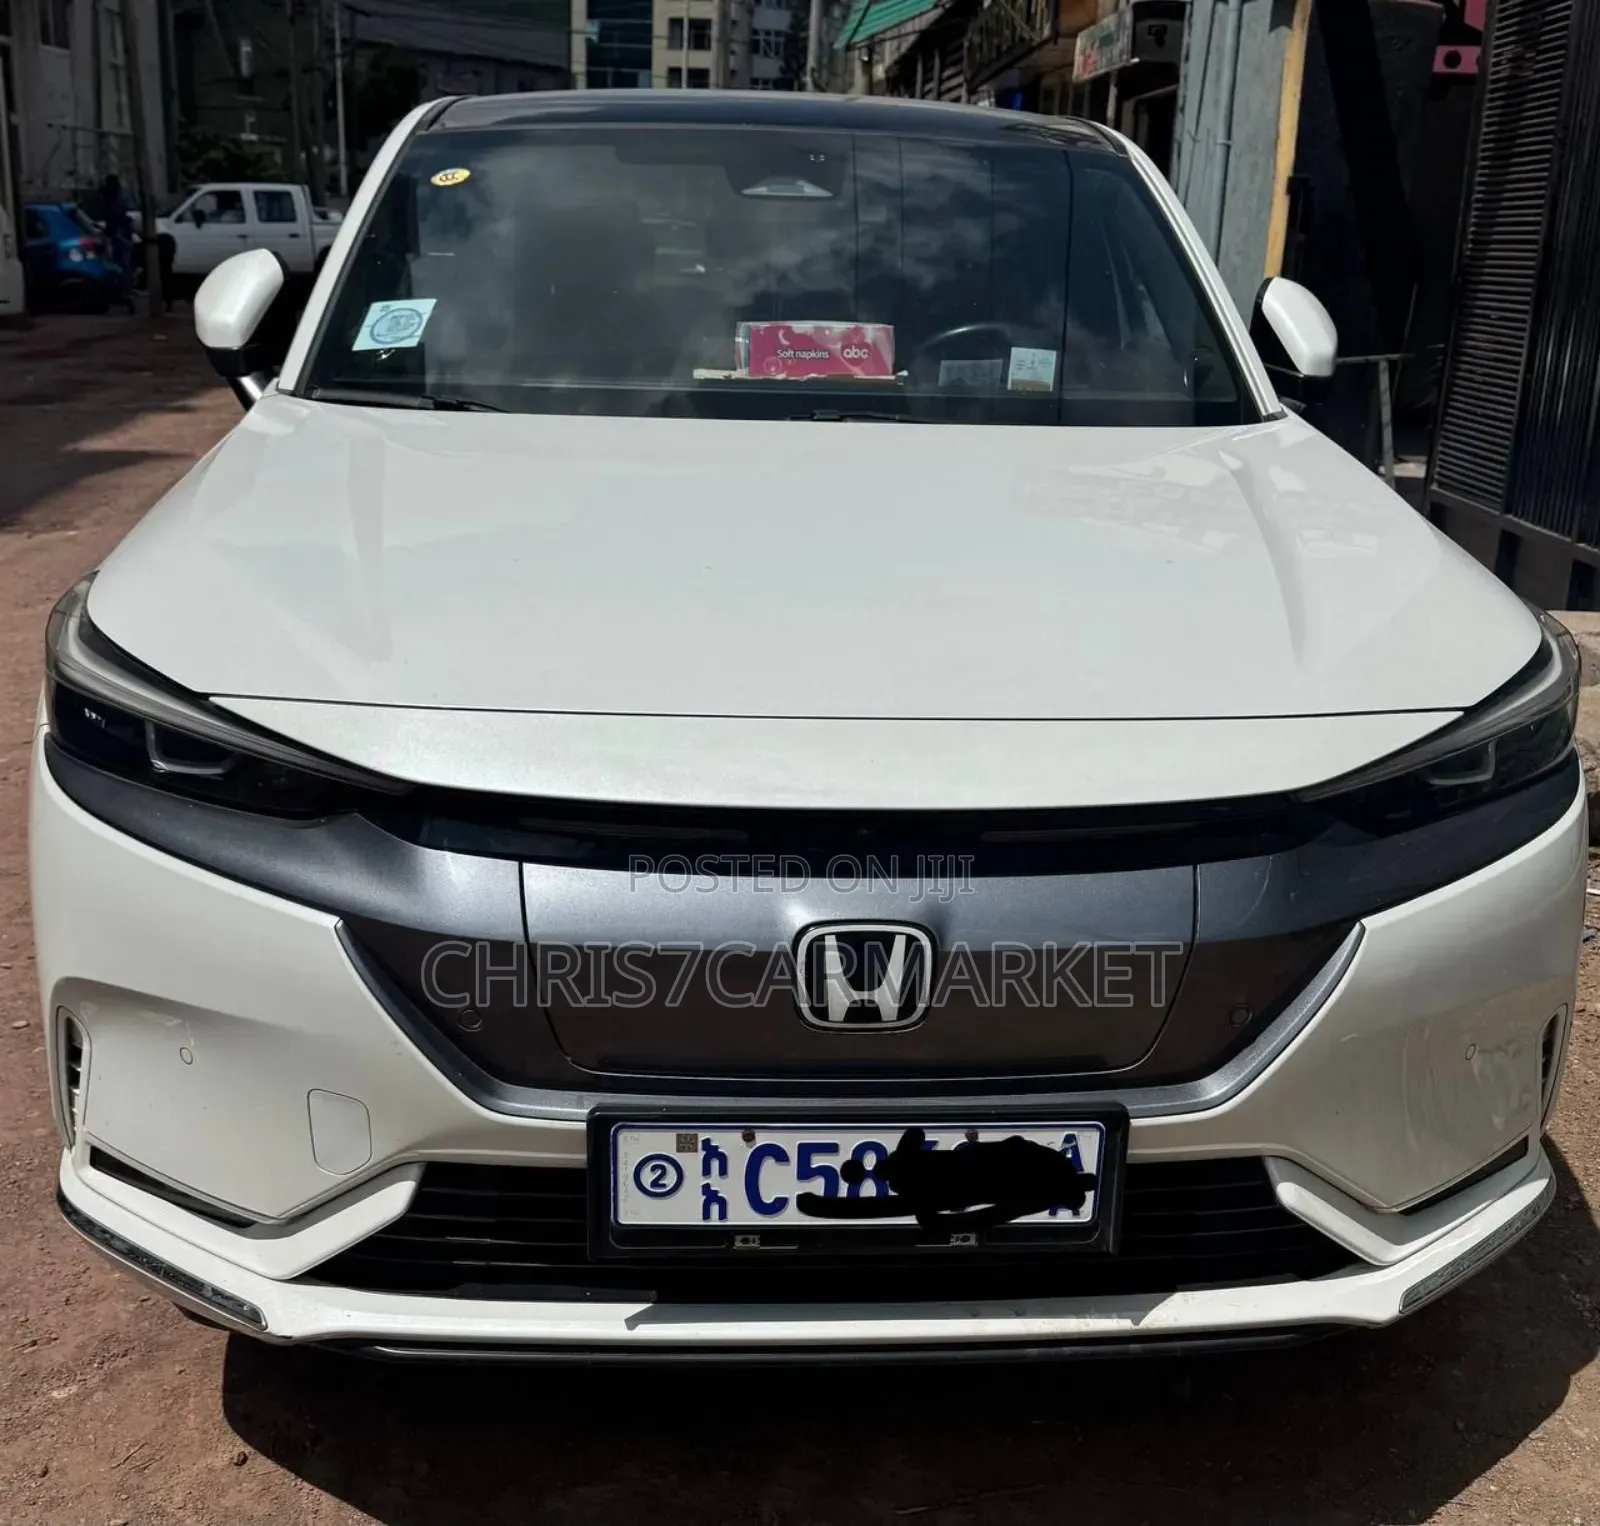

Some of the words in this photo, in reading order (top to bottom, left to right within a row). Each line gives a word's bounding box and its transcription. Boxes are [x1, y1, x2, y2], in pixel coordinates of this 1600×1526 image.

[777, 349, 794, 359] Soft
[795, 349, 829, 360] napkins
[843, 345, 869, 359] abc
[649, 1163, 667, 1189] 2
